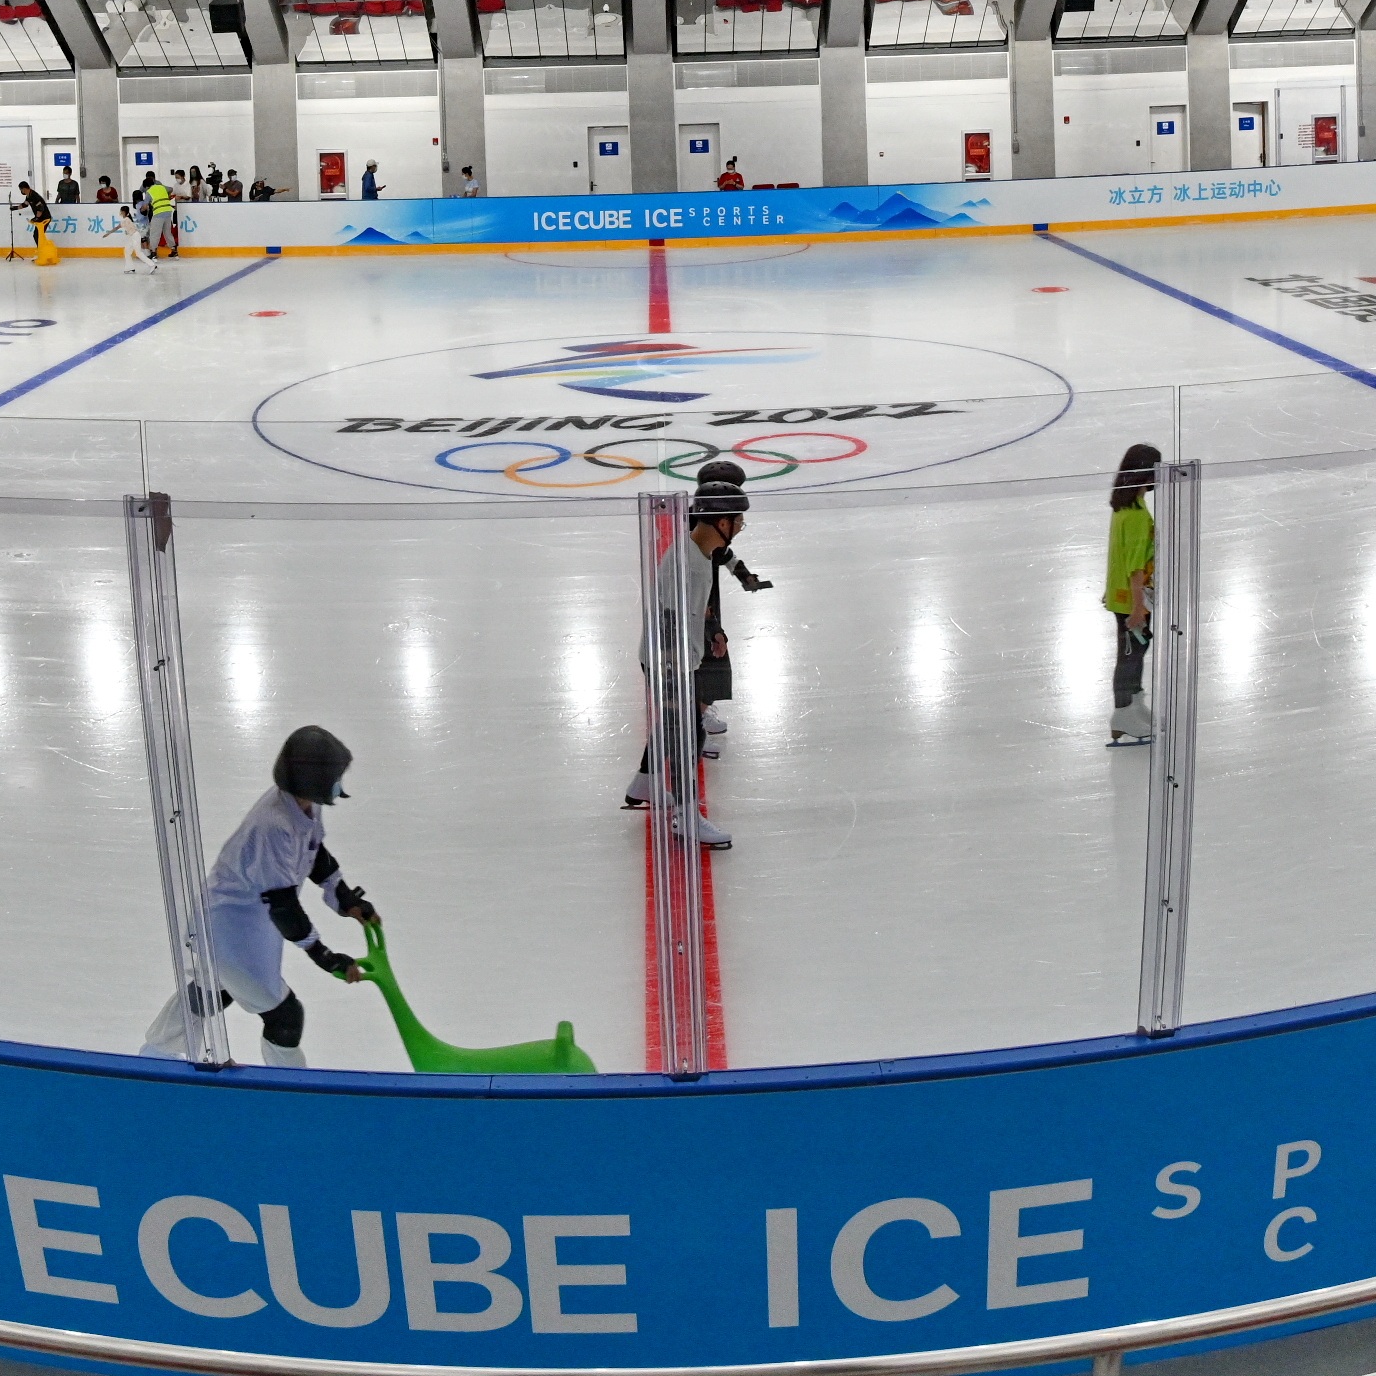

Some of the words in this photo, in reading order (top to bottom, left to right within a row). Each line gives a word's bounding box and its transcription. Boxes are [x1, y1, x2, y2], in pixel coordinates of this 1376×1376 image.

[1109, 185, 1164, 206] 冰立方
[1174, 179, 1281, 202] 冰上运动中心
[645, 209, 683, 228] ICE
[689, 206, 769, 217] SPORTS
[702, 215, 784, 226] CENTER
[336, 413, 674, 438] BEIJING
[708, 401, 966, 426] 2022
[765, 1177, 1095, 1330] ICE
